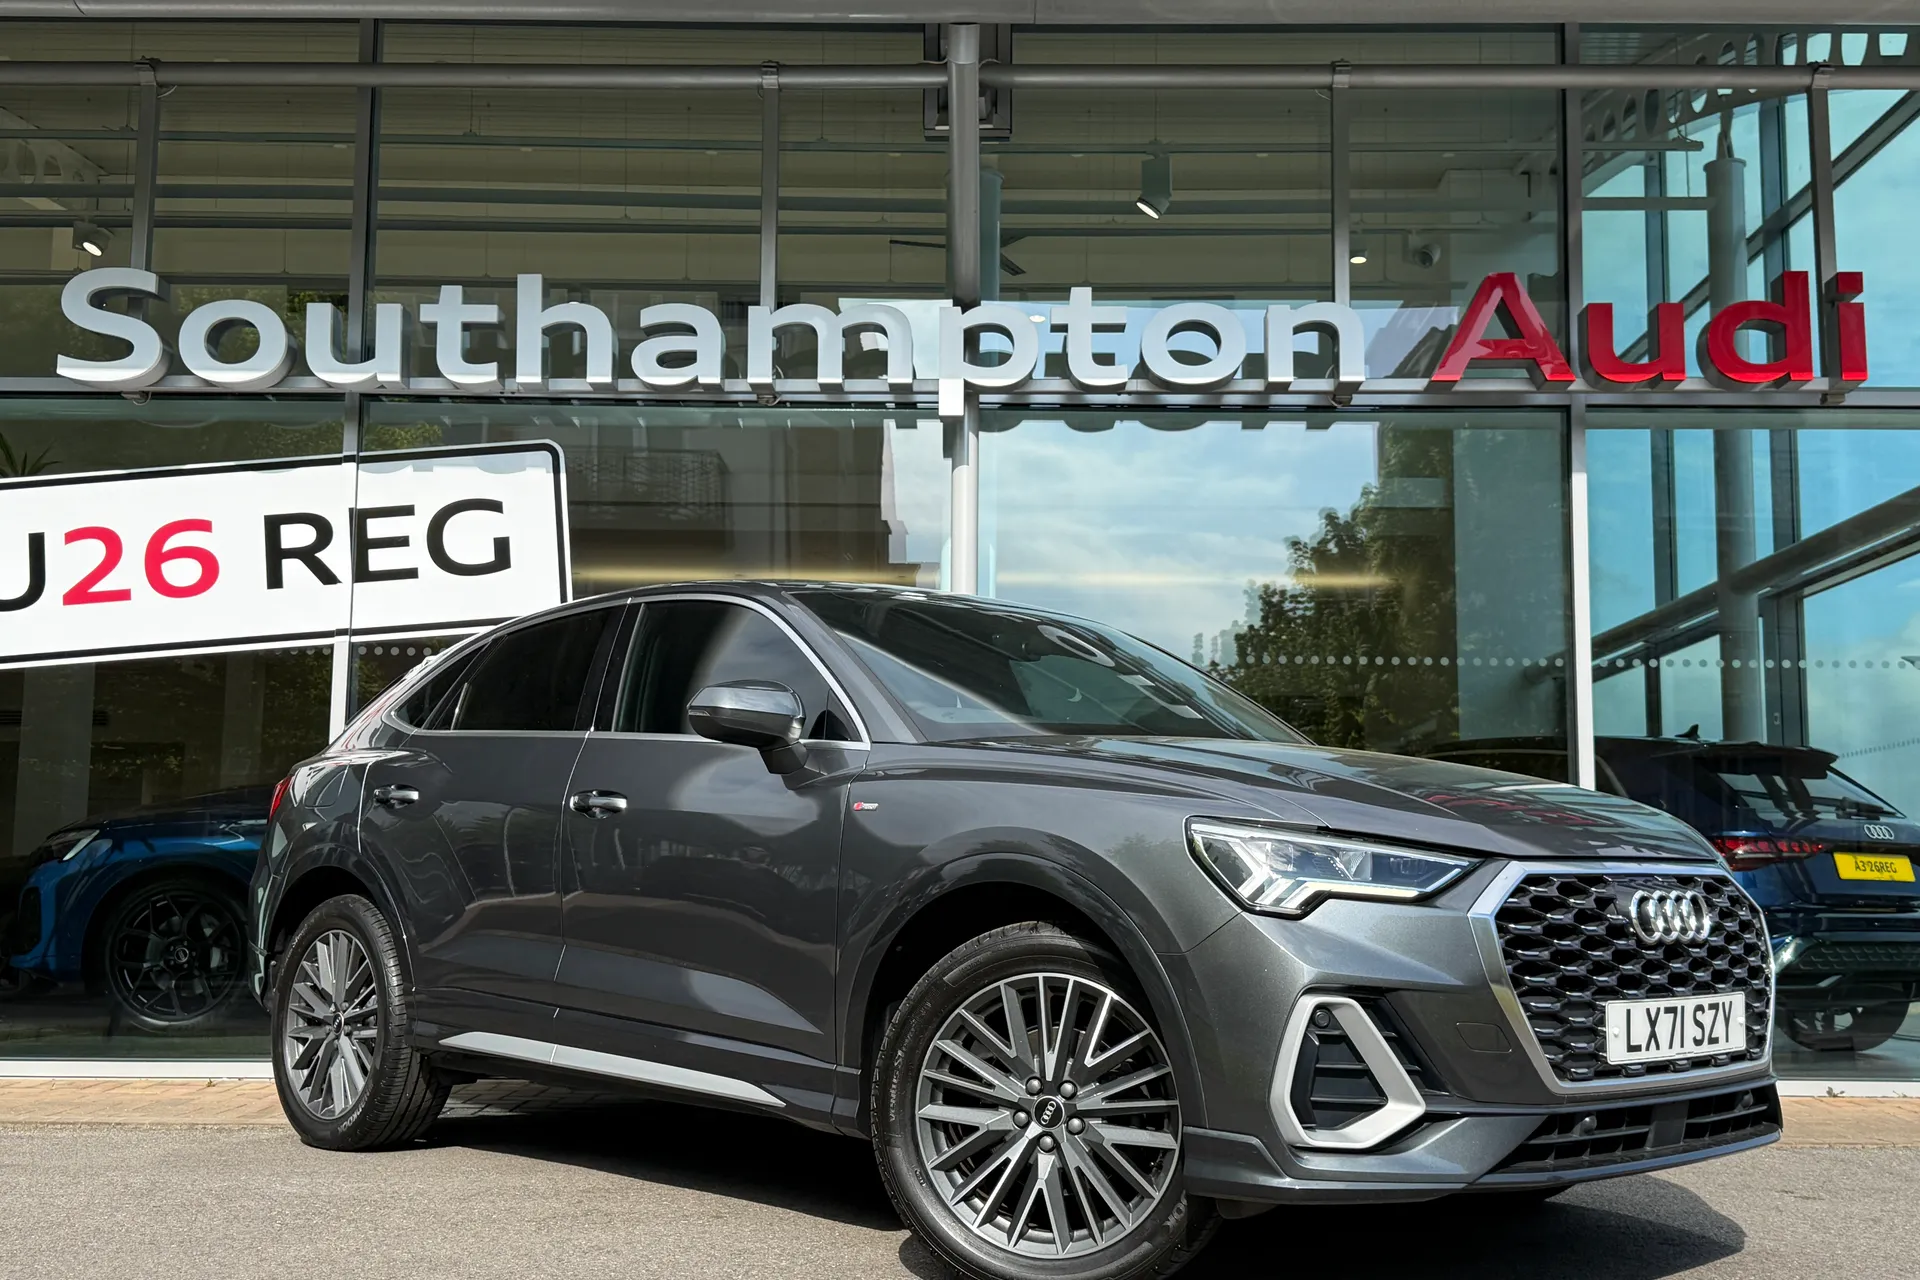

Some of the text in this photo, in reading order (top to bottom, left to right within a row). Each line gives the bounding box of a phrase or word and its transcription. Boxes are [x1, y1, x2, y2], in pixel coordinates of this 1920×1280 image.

[57, 269, 1868, 419] Southampton Audi
[263, 498, 512, 590] REG
[1626, 1000, 1733, 1053] LX71 SZY
